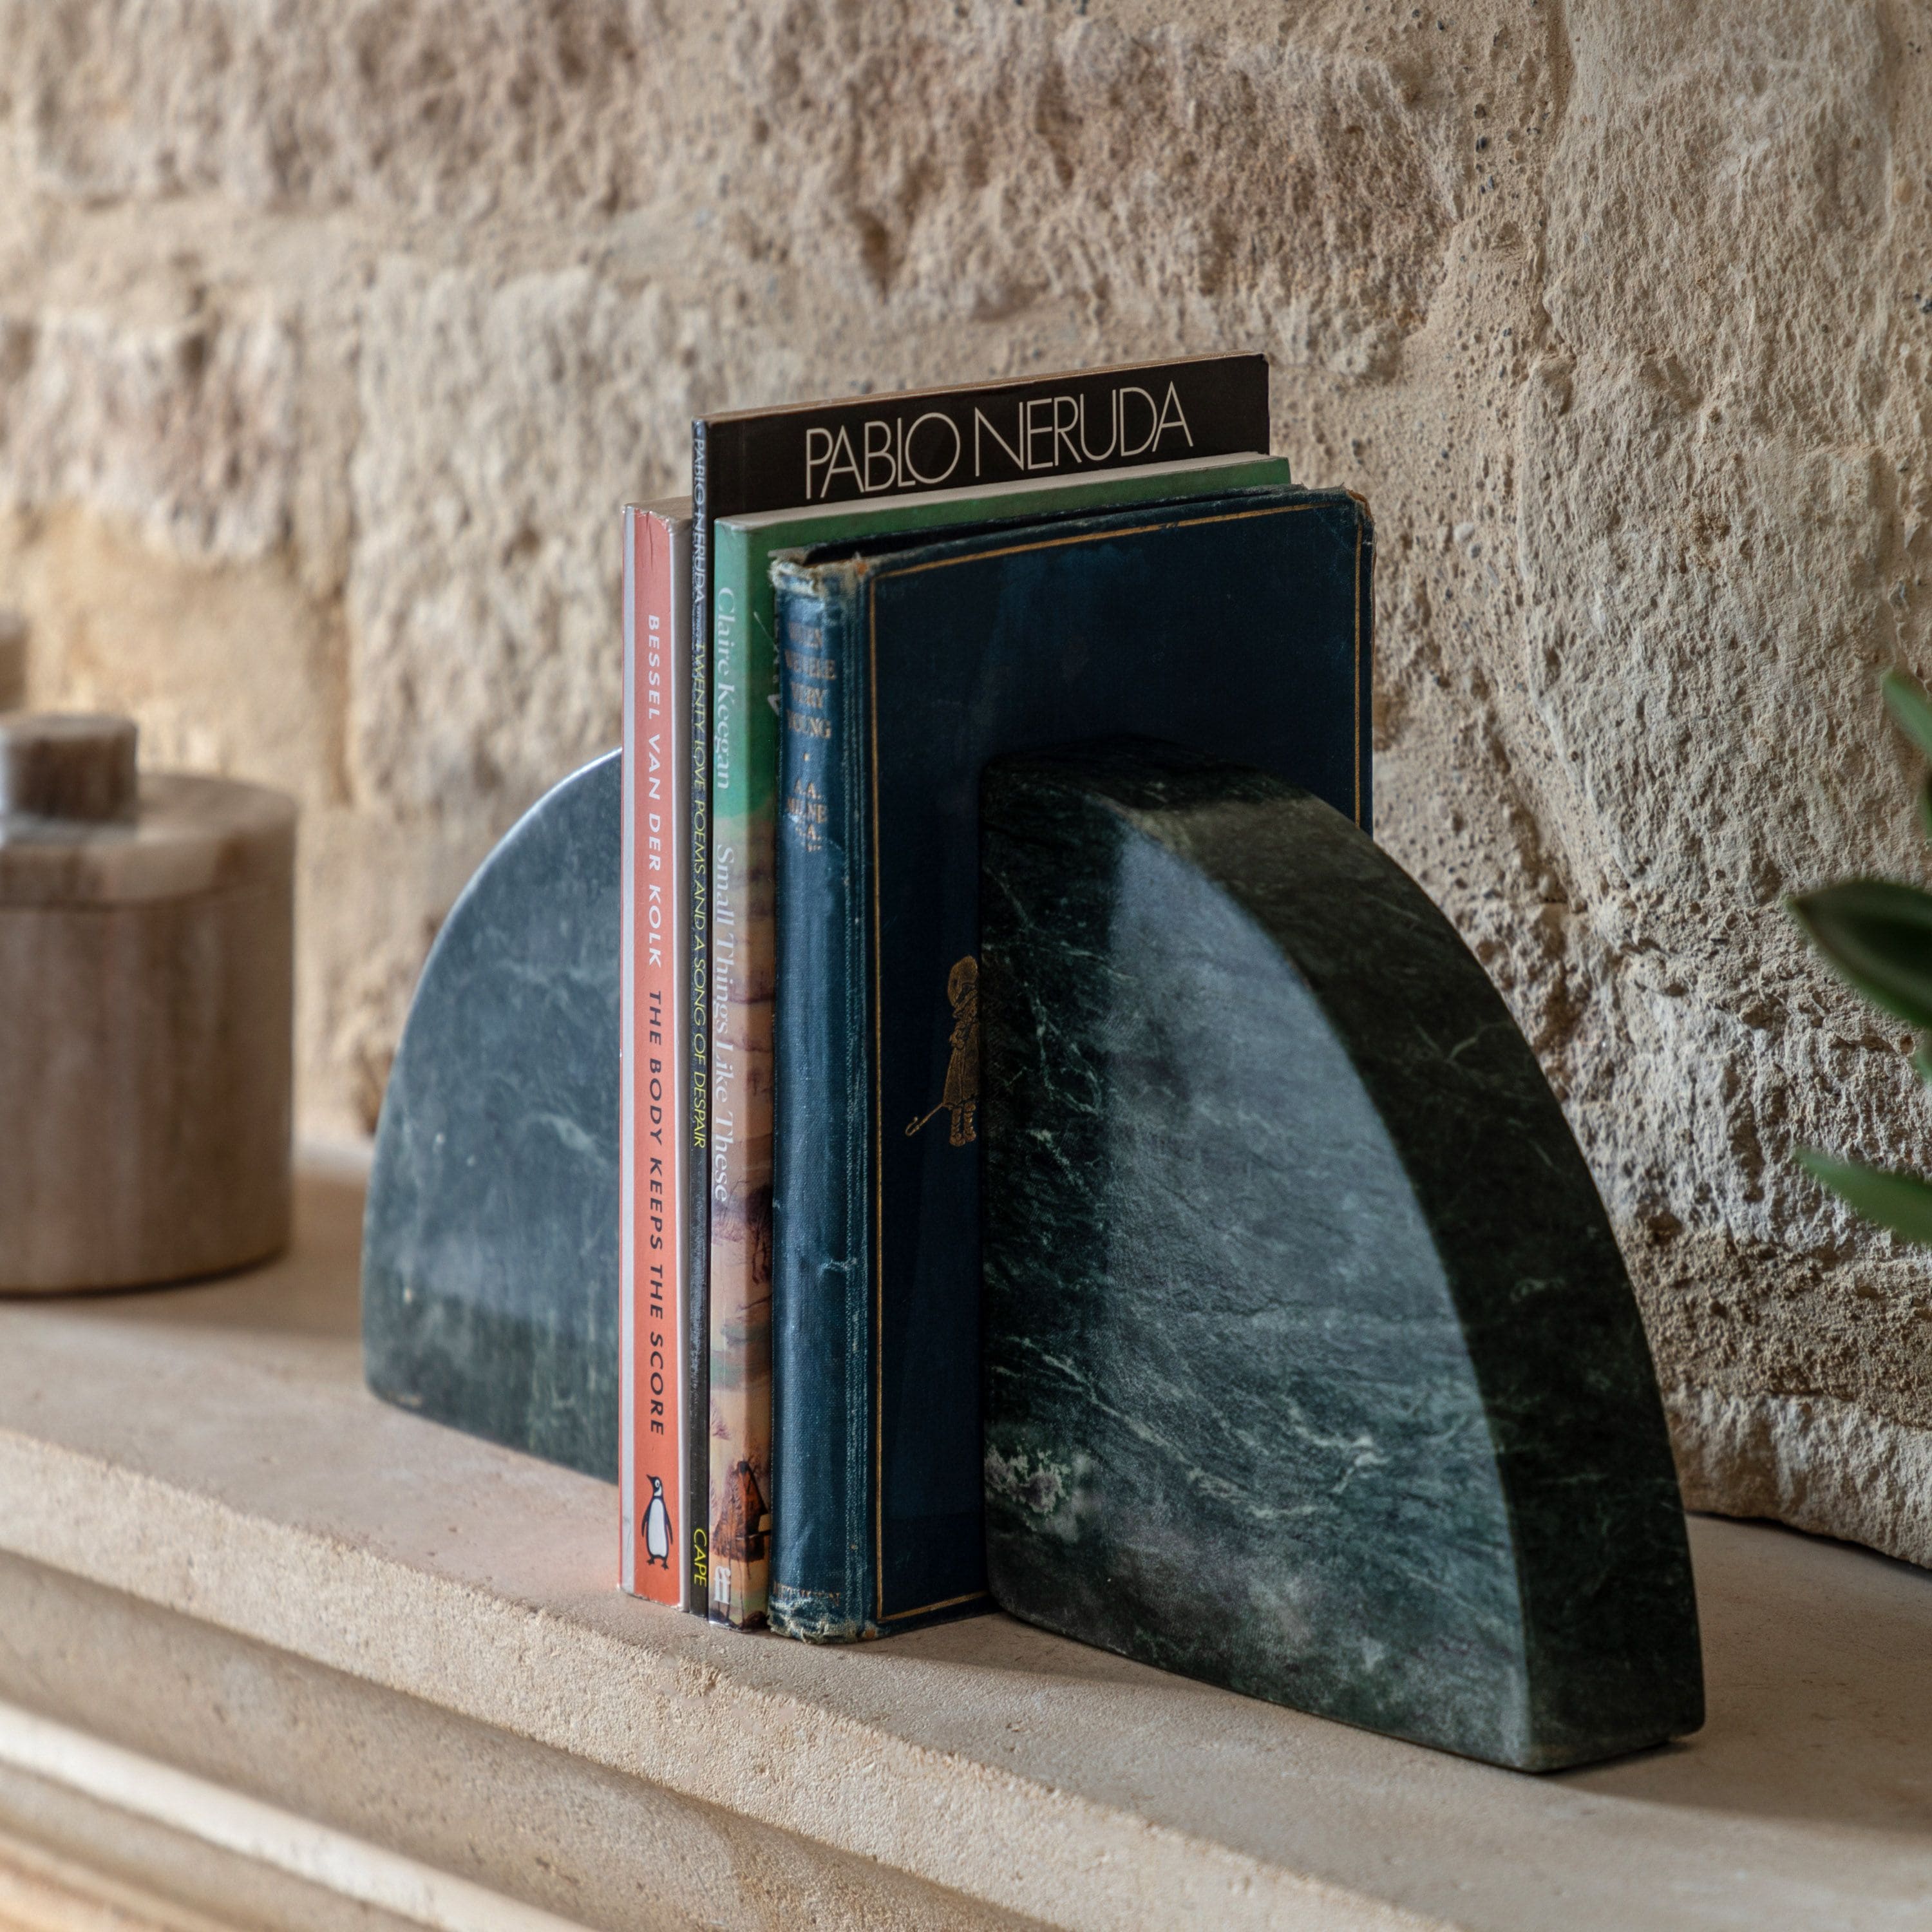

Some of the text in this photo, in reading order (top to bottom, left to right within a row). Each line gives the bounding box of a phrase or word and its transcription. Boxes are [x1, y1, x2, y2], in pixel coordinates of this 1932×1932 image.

[694, 438, 706, 506] PABLO
[806, 380, 1194, 500] PABLO NERUDA
[693, 513, 706, 603] NERUDA
[694, 643, 706, 733] TWENTY
[714, 587, 735, 789] Claire Keegan
[649, 615, 661, 968] BESSEL VAN DER KOLK
[694, 740, 706, 793] LOVE
[694, 800, 706, 875] POEMS
[694, 880, 706, 930] AND
[694, 935, 705, 951] A
[694, 958, 706, 1026] SONG
[713, 844, 735, 1202] Small Things Like These
[694, 1033, 706, 1066] OF
[694, 1072, 706, 1148] DESPAIR
[649, 990, 664, 1435] THE BODY KEEPS THE SCORE
[693, 1528, 707, 1587] CAPE
